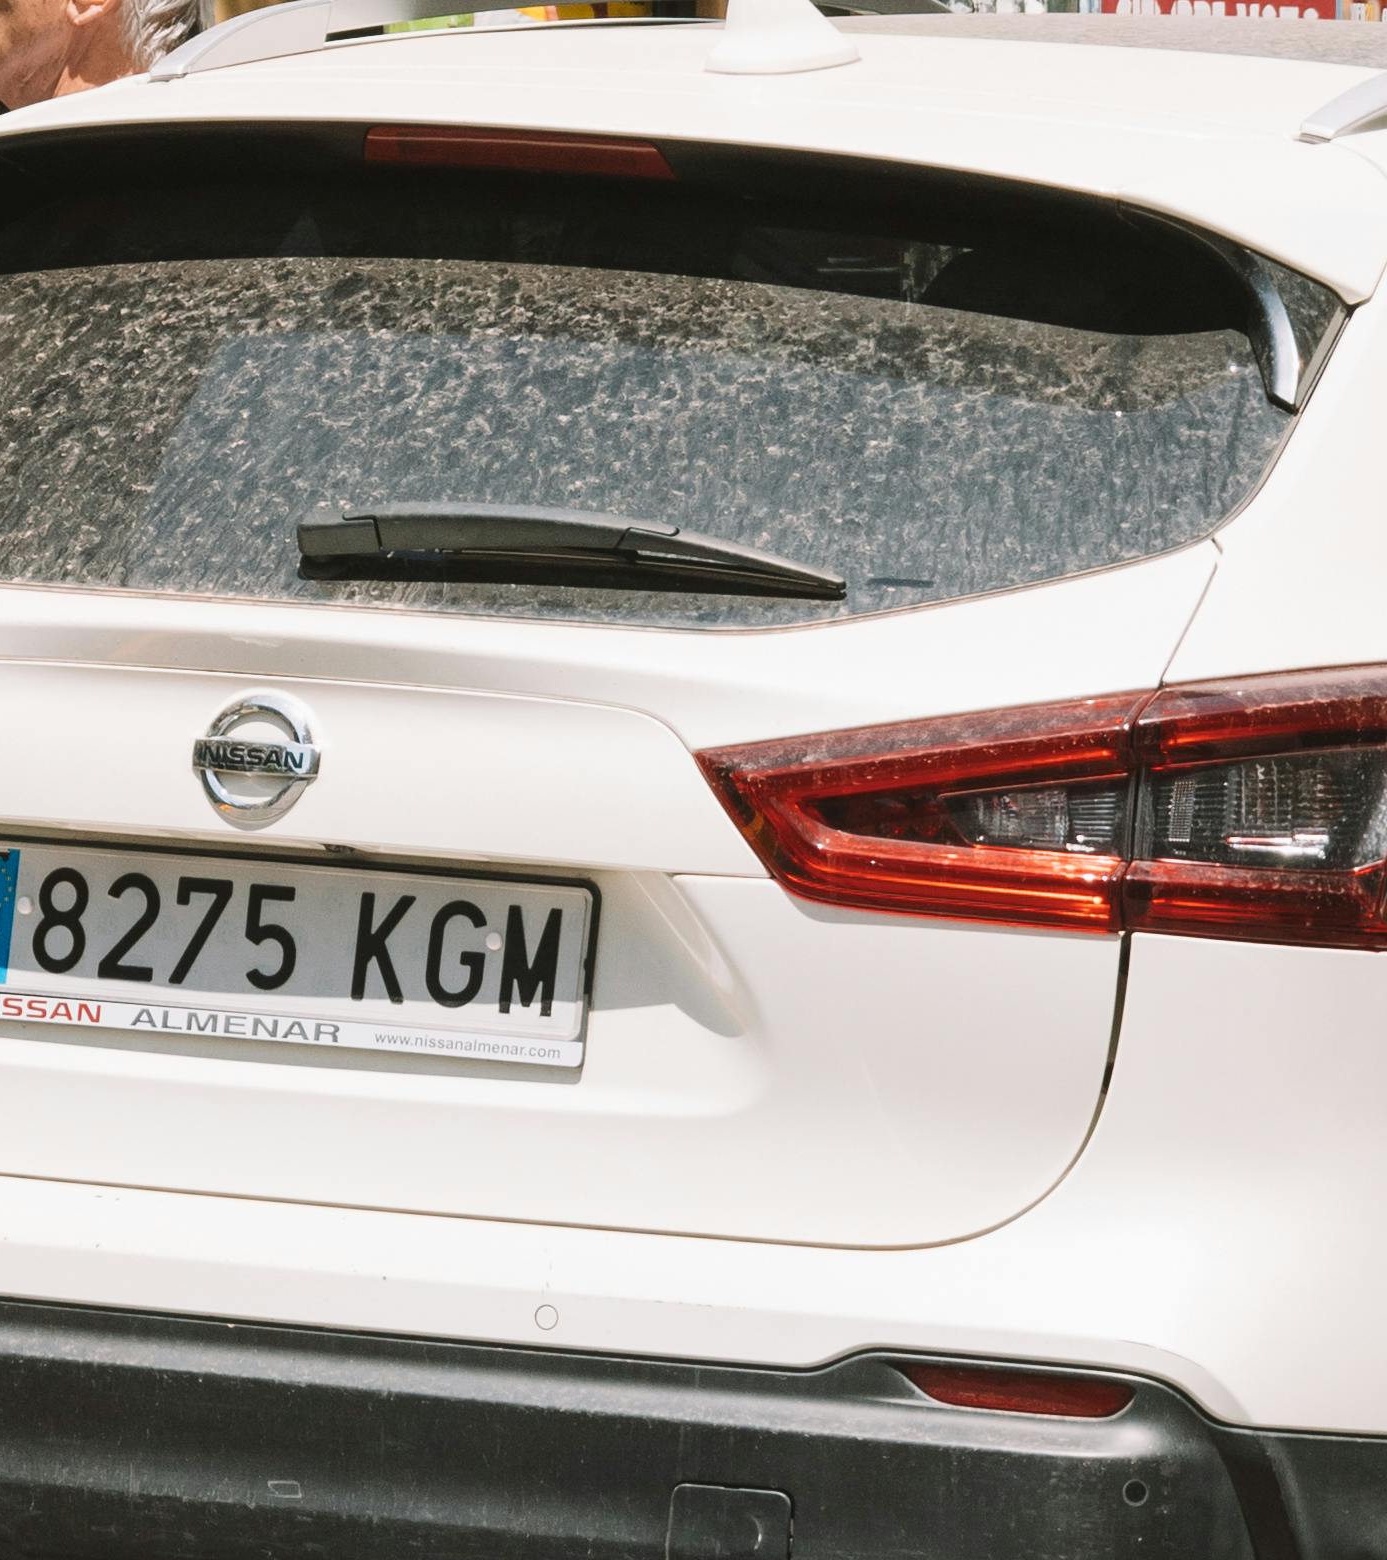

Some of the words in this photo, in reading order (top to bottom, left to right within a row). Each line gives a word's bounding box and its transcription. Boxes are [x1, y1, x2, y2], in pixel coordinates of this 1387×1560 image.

[199, 741, 306, 773] NISSAN
[31, 866, 300, 995] 8275
[350, 890, 565, 1020] KGM
[130, 1006, 343, 1046] ALMENAR
[372, 1028, 564, 1064] www.nissanalmenar.com
